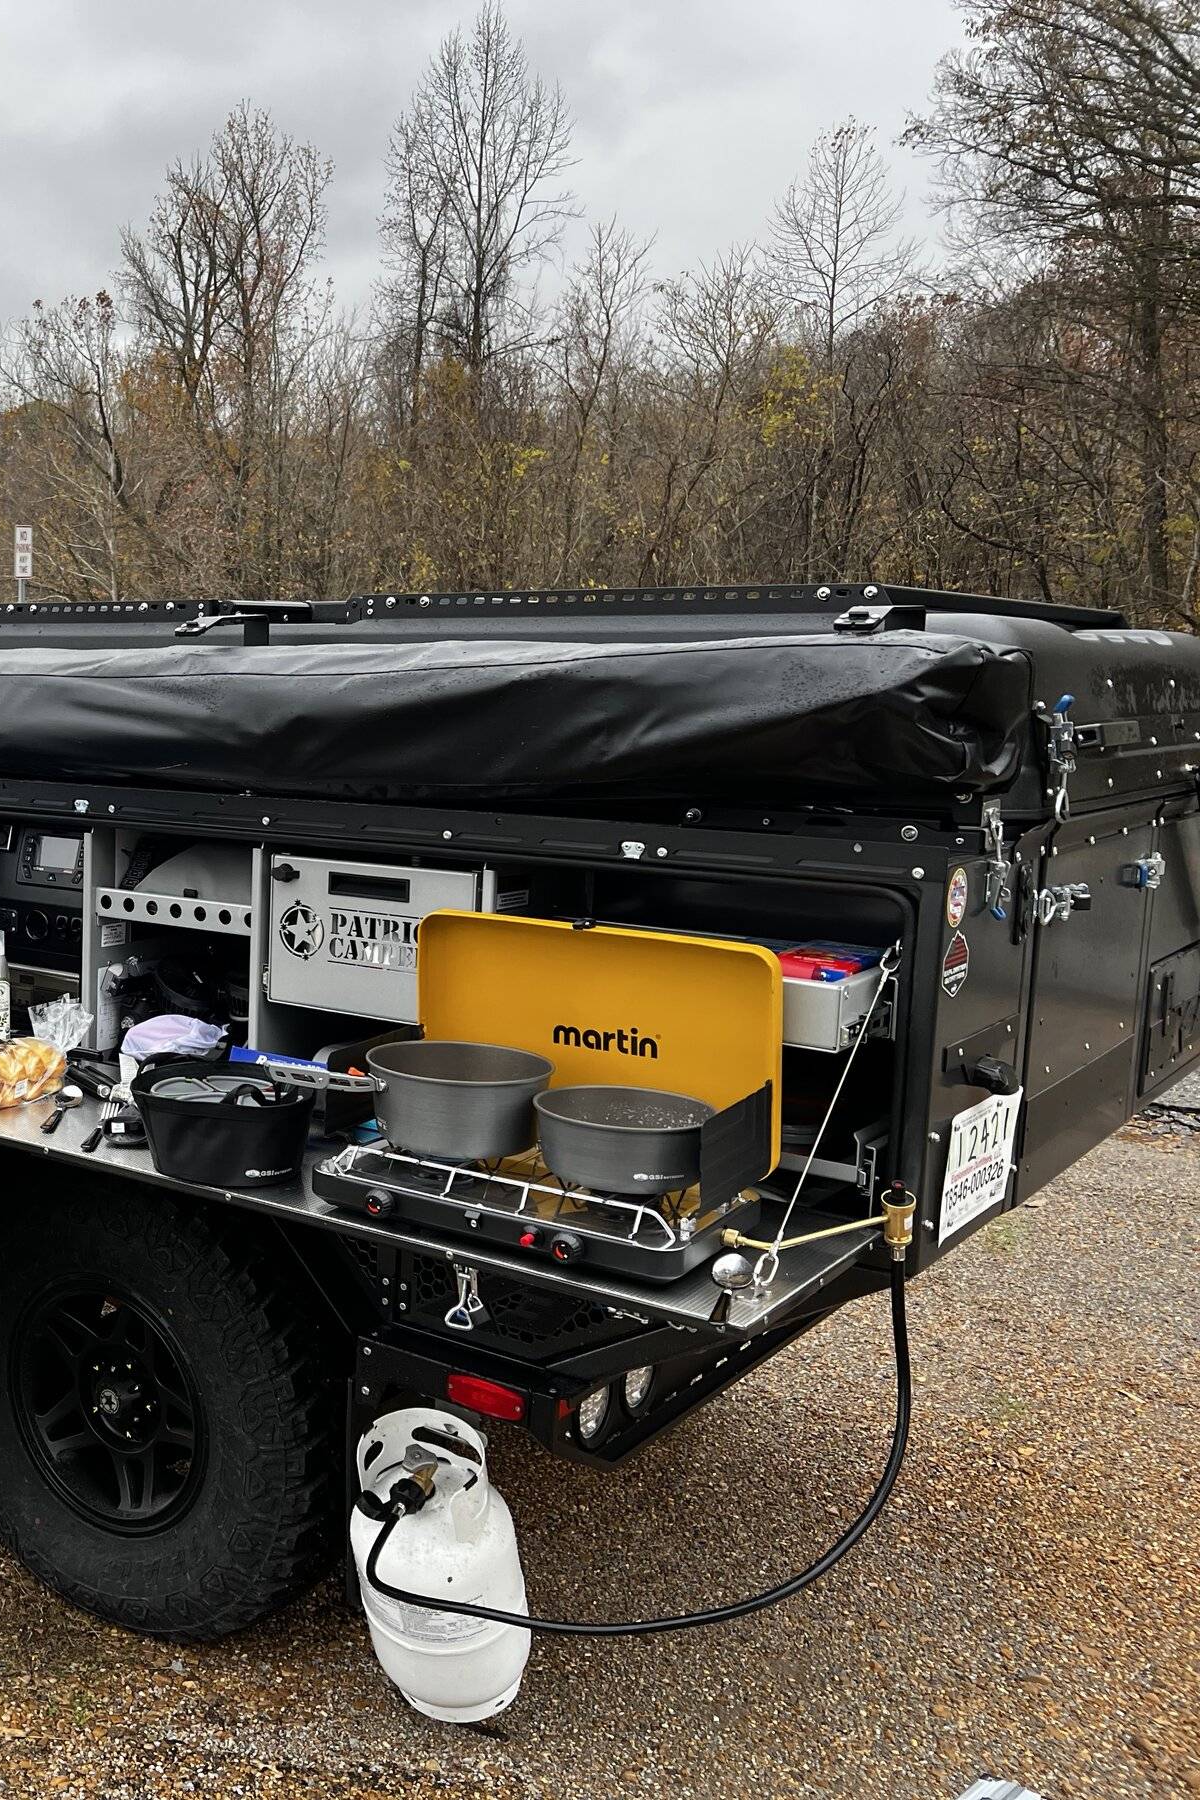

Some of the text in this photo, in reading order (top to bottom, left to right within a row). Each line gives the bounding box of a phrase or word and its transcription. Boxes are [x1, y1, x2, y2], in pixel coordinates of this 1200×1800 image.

[330, 913, 420, 944] PATRI
[329, 938, 419, 968] CAMPE
[553, 1024, 658, 1059] martin
